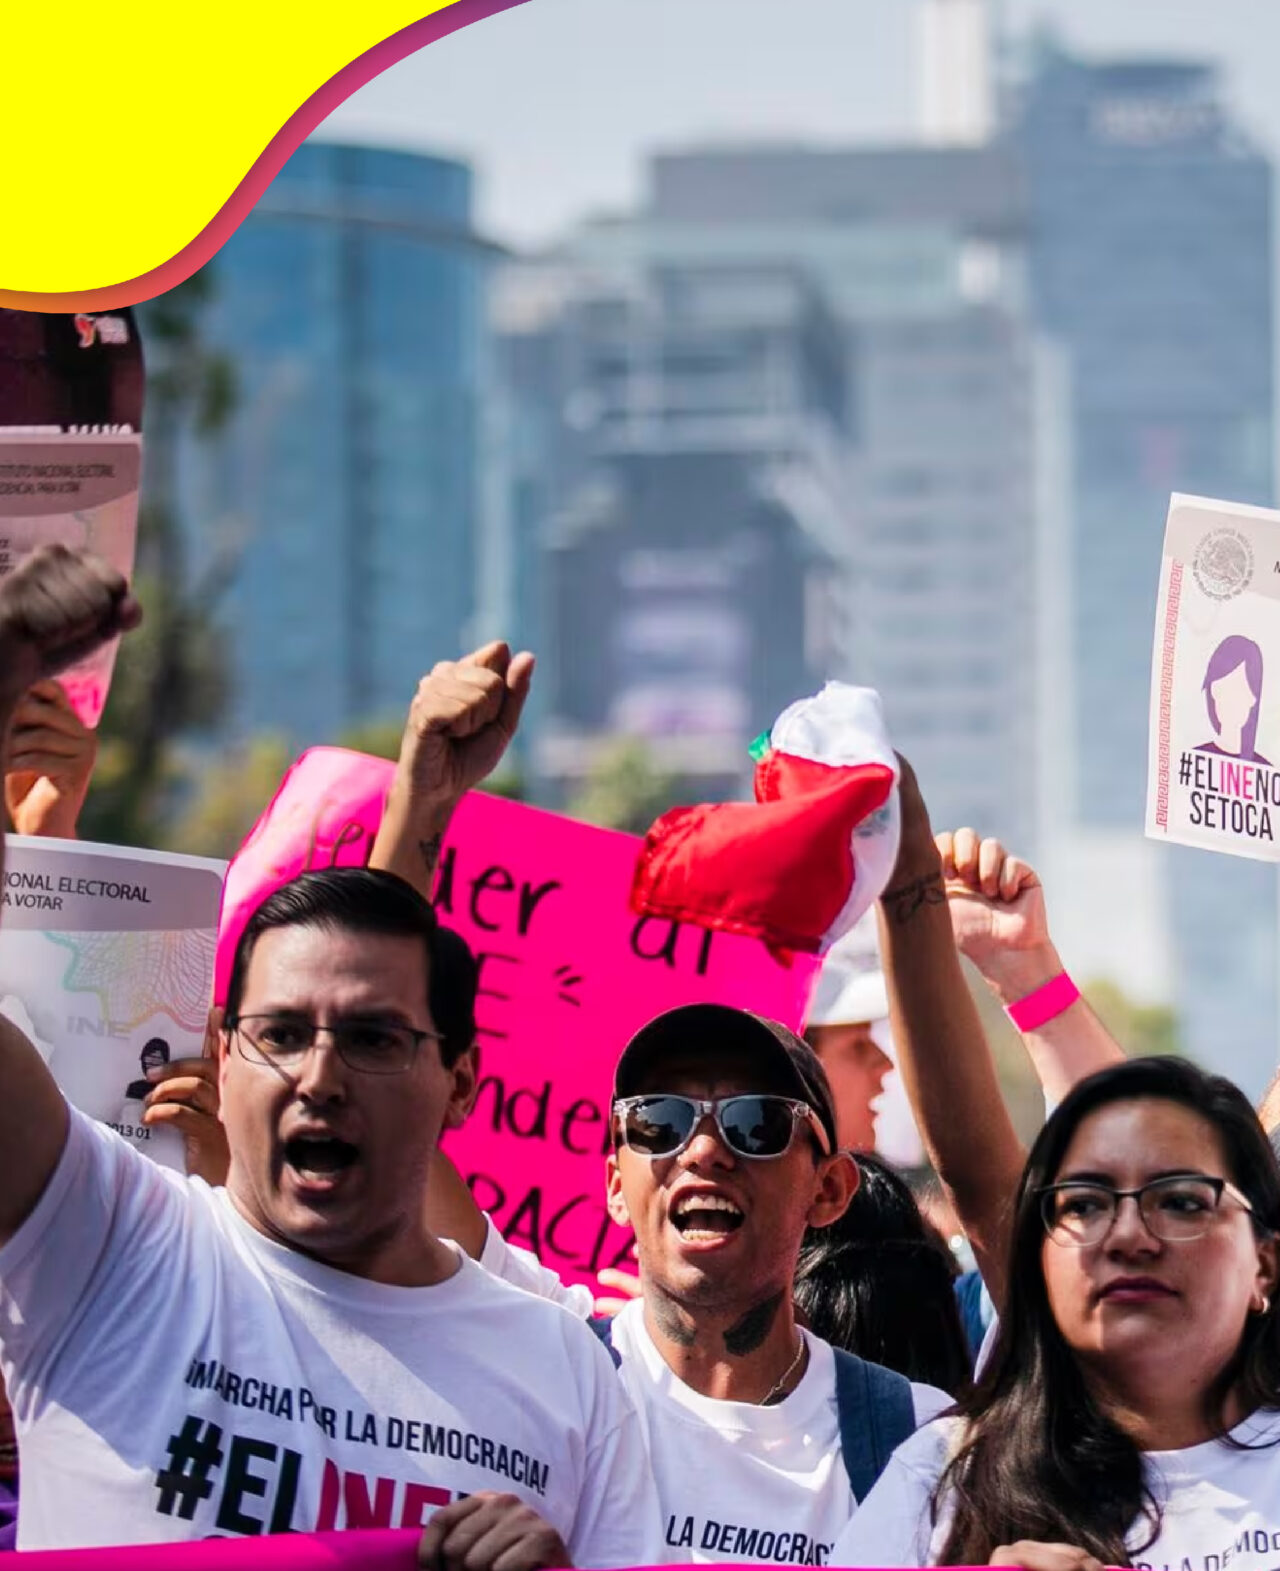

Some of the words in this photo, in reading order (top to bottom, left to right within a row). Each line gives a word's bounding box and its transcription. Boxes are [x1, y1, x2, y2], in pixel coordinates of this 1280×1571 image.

[1189, 791, 1274, 841] SETOCA
[15, 893, 63, 911] VOTAR
[58, 876, 152, 903] ELECTORAL
[136, 1127, 150, 1140] 01
[184, 1358, 294, 1421] ¡MARCHA
[345, 1410, 378, 1446] LA
[386, 1416, 550, 1497] DEMOCRACIA!
[665, 1515, 695, 1547] LA
